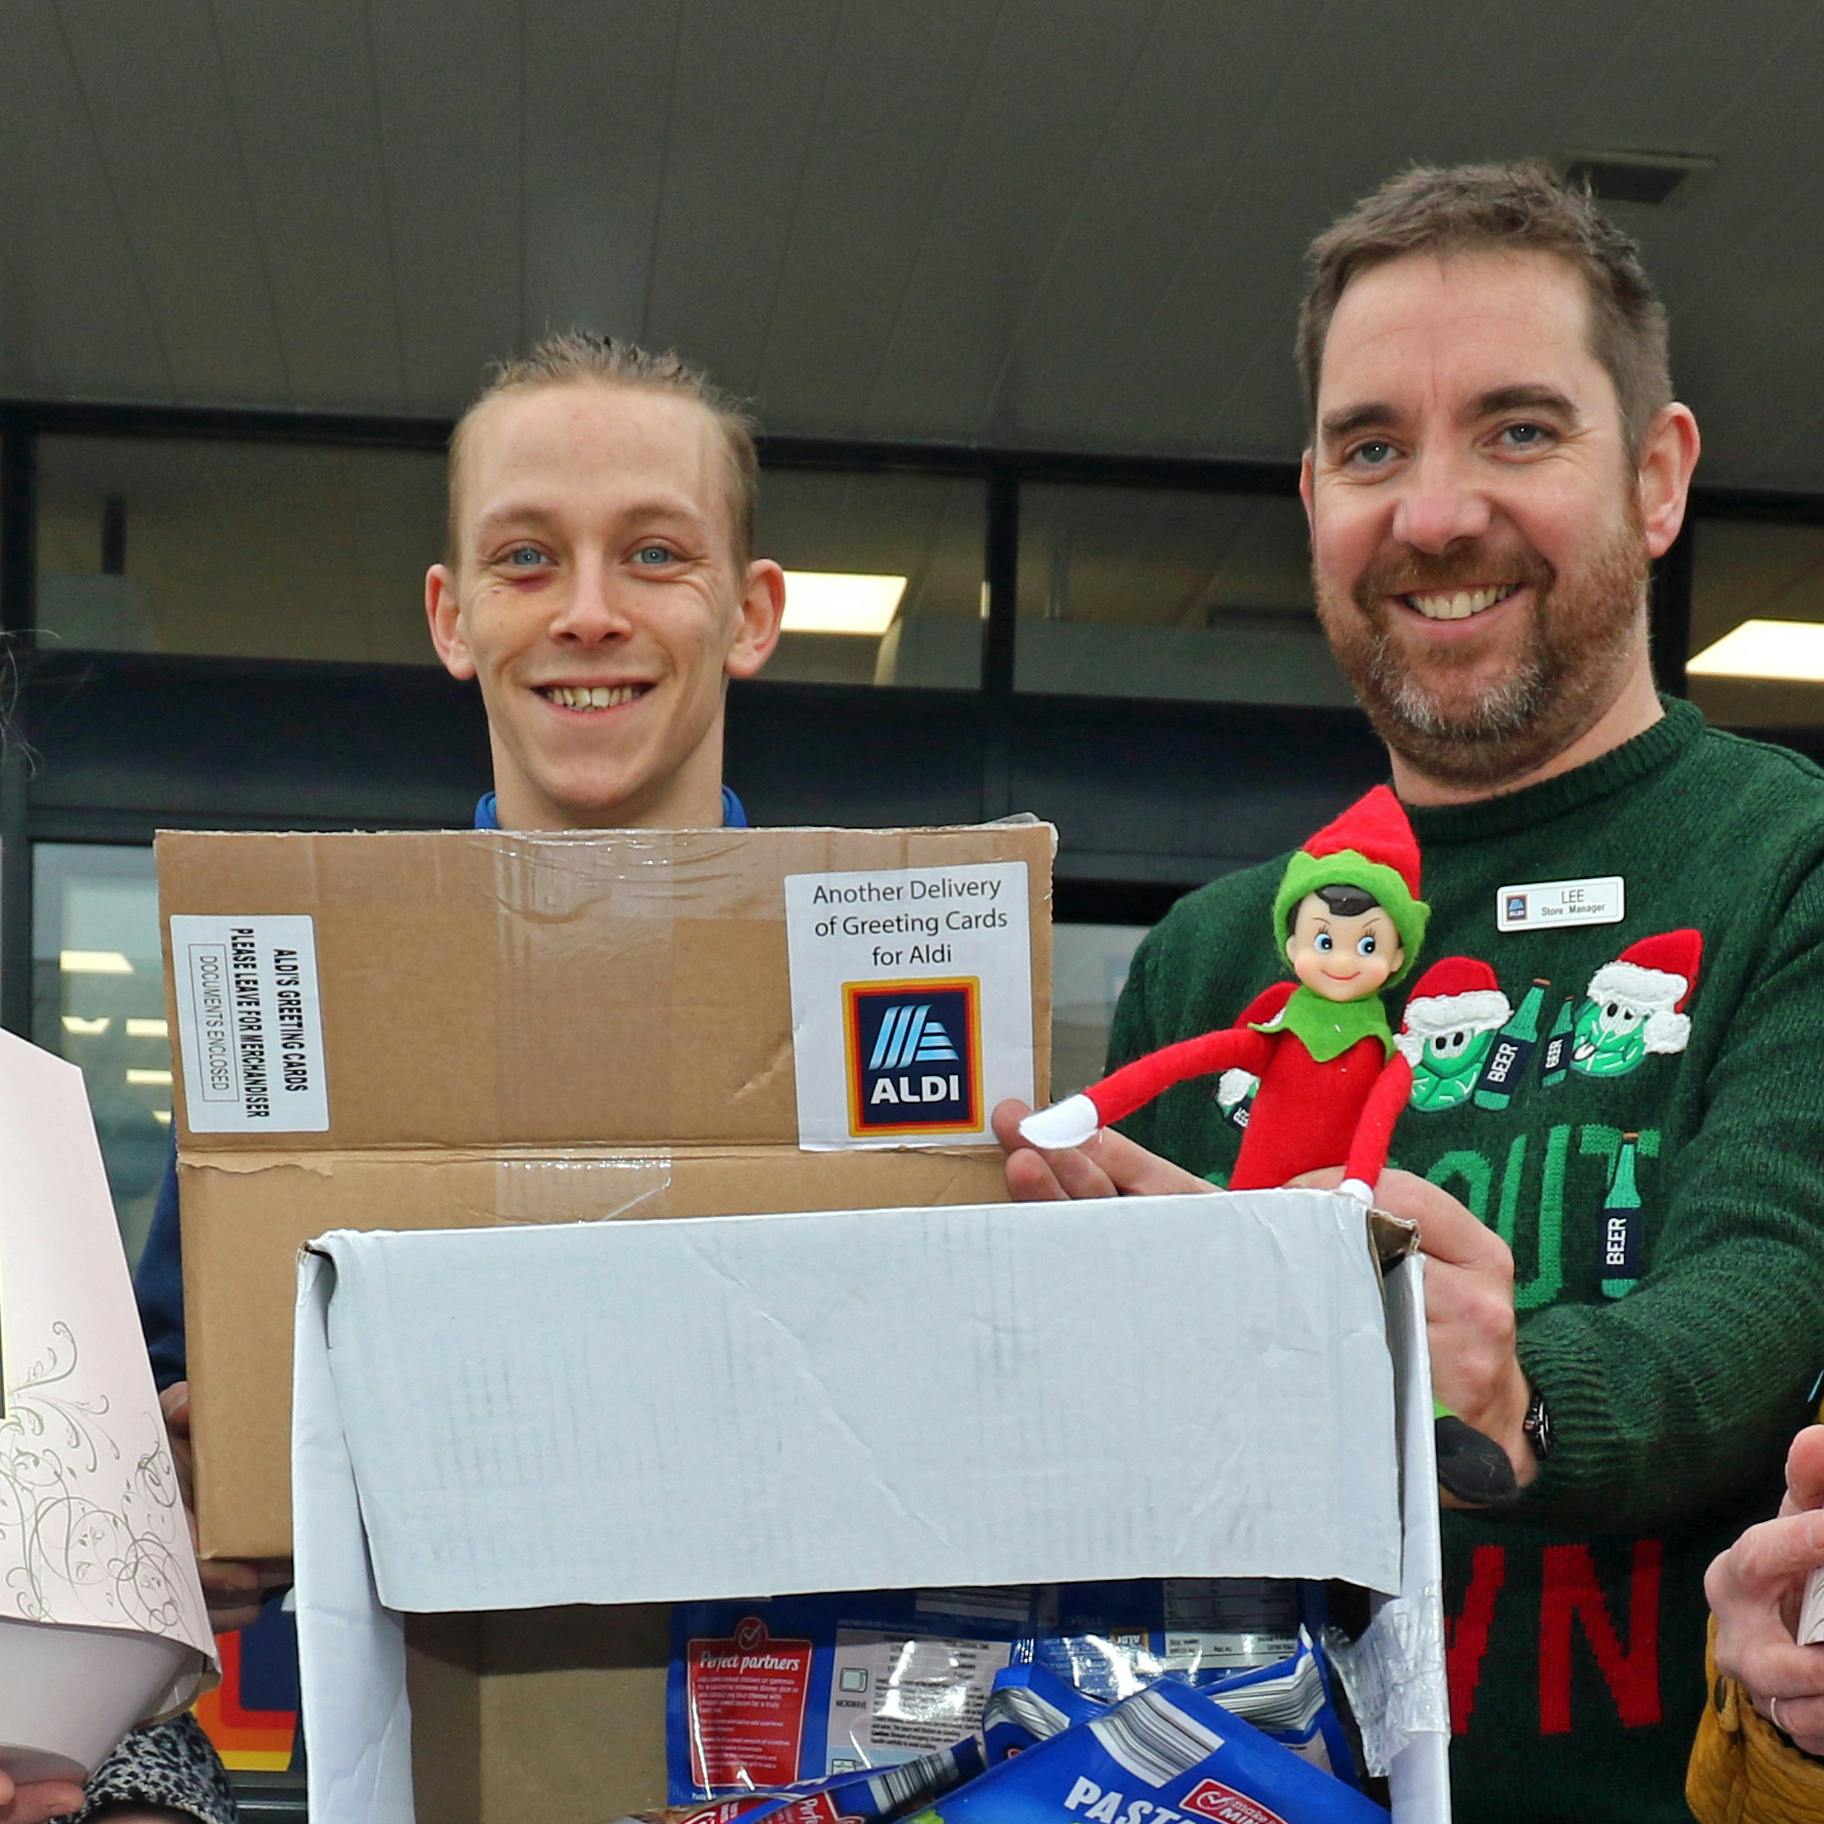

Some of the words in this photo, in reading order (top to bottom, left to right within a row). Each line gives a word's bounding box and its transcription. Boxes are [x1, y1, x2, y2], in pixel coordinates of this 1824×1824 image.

[813, 883, 904, 904] Another
[910, 879, 1001, 900] Delivery
[1561, 889, 1584, 904] LEE
[815, 917, 836, 937] of
[843, 914, 939, 936] Greeting
[945, 908, 1008, 930] Cards
[1541, 906, 1564, 917] Store
[1569, 903, 1606, 915] Manager
[230, 928, 258, 969] PLEASE
[873, 946, 903, 966] for
[910, 944, 952, 964] Aldi
[274, 948, 300, 986] ALDI'S
[200, 956, 224, 1027] DOCUMENTS
[234, 973, 260, 1006] LEAVE
[238, 1010, 263, 1032] FOR
[278, 990, 305, 1050] GREETING
[207, 1031, 230, 1090] ENCLOSED
[240, 1034, 270, 1118] MERCHANDISER
[283, 1053, 308, 1092] CARDS
[1487, 1042, 1519, 1083] BEER
[870, 1074, 960, 1104] ALDI
[1606, 1216, 1627, 1266] BEER
[699, 1651, 738, 1672] Perfect
[740, 1653, 800, 1674] partners
[1231, 1796, 1267, 1823] make
